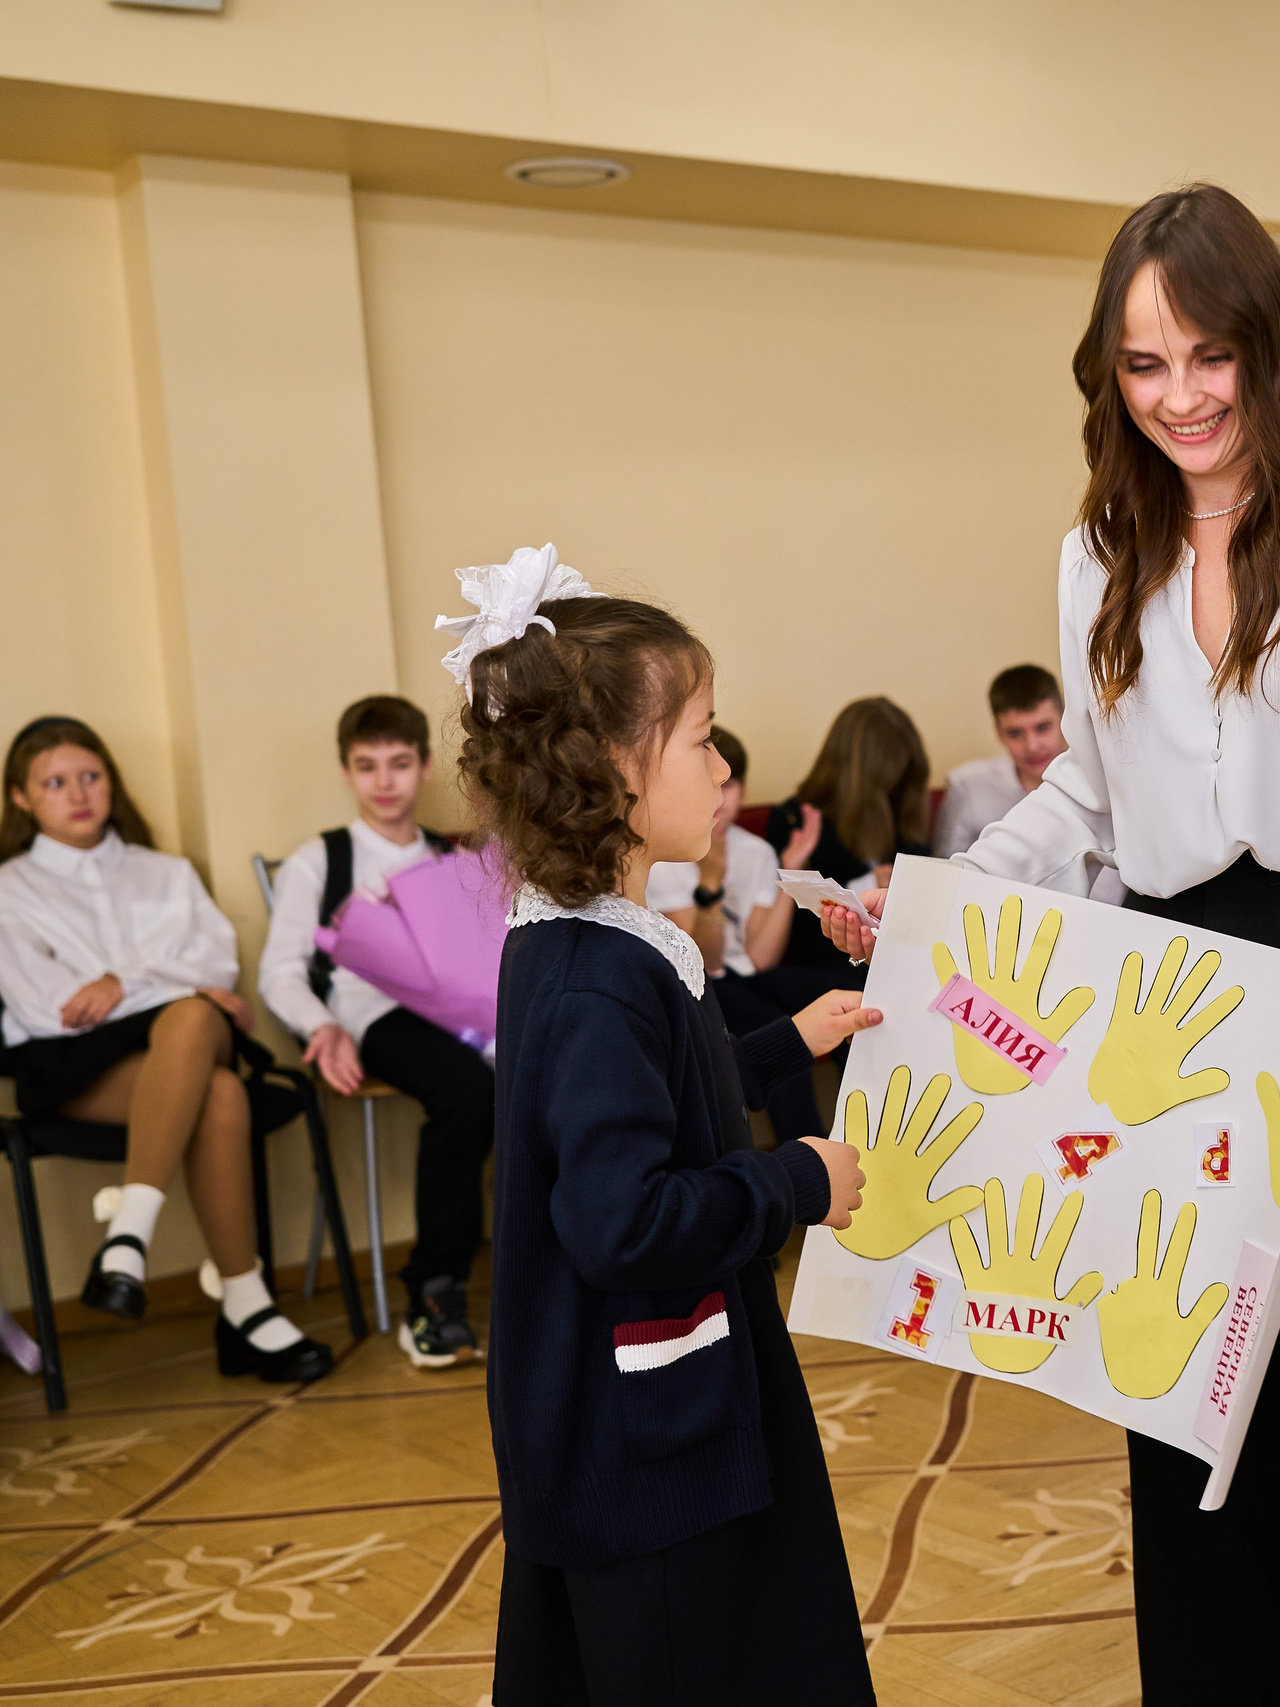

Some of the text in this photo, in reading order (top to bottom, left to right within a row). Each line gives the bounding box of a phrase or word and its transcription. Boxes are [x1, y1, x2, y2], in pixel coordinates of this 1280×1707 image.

[948, 996, 1048, 1074] АЛИЯ
[888, 1267, 942, 1354] 1
[963, 1301, 1070, 1341] МАРК
[1210, 1285, 1247, 1404] ВЕНЕЦИЯ
[1218, 1286, 1257, 1416] СЕВЕРНАЯ
